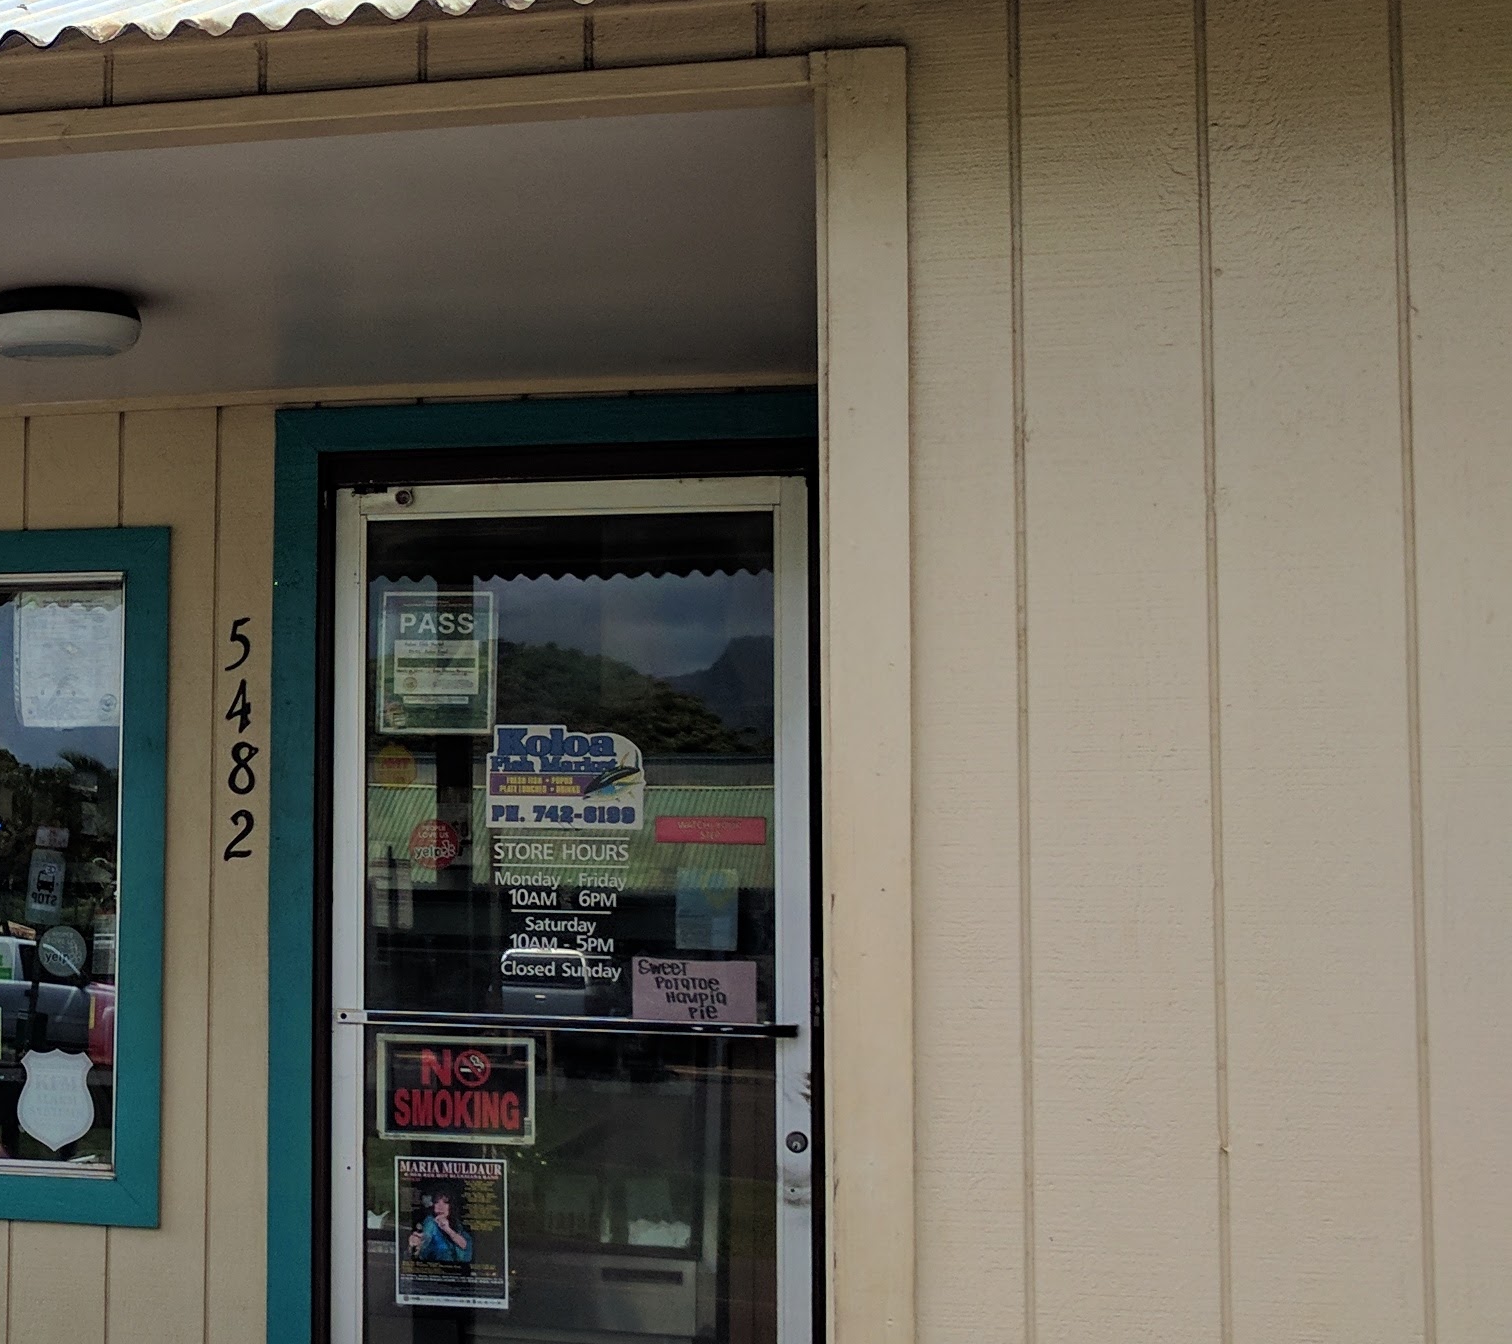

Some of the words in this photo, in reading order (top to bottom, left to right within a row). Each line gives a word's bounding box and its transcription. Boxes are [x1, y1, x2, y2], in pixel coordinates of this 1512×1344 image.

[399, 612, 475, 635] PASS
[224, 617, 259, 862] 5482
[497, 728, 617, 757] Koloa
[490, 756, 535, 772] Fish
[539, 756, 618, 773] Market
[414, 845, 442, 860] yelp
[494, 842, 553, 860] STORE
[562, 843, 629, 862] HOURS
[494, 871, 561, 890] Monday
[578, 872, 627, 891] Friday
[508, 888, 557, 906] 10AM
[578, 890, 617, 908] 6PM
[525, 916, 597, 935] Saturday
[509, 933, 558, 949] 10AM
[576, 935, 614, 952] 5PM
[500, 960, 556, 976] Closed
[561, 962, 622, 982] Sunday
[394, 1087, 520, 1130] SMOKING
[399, 1160, 439, 1174] MARIA
[441, 1161, 502, 1176] MULDAUR
